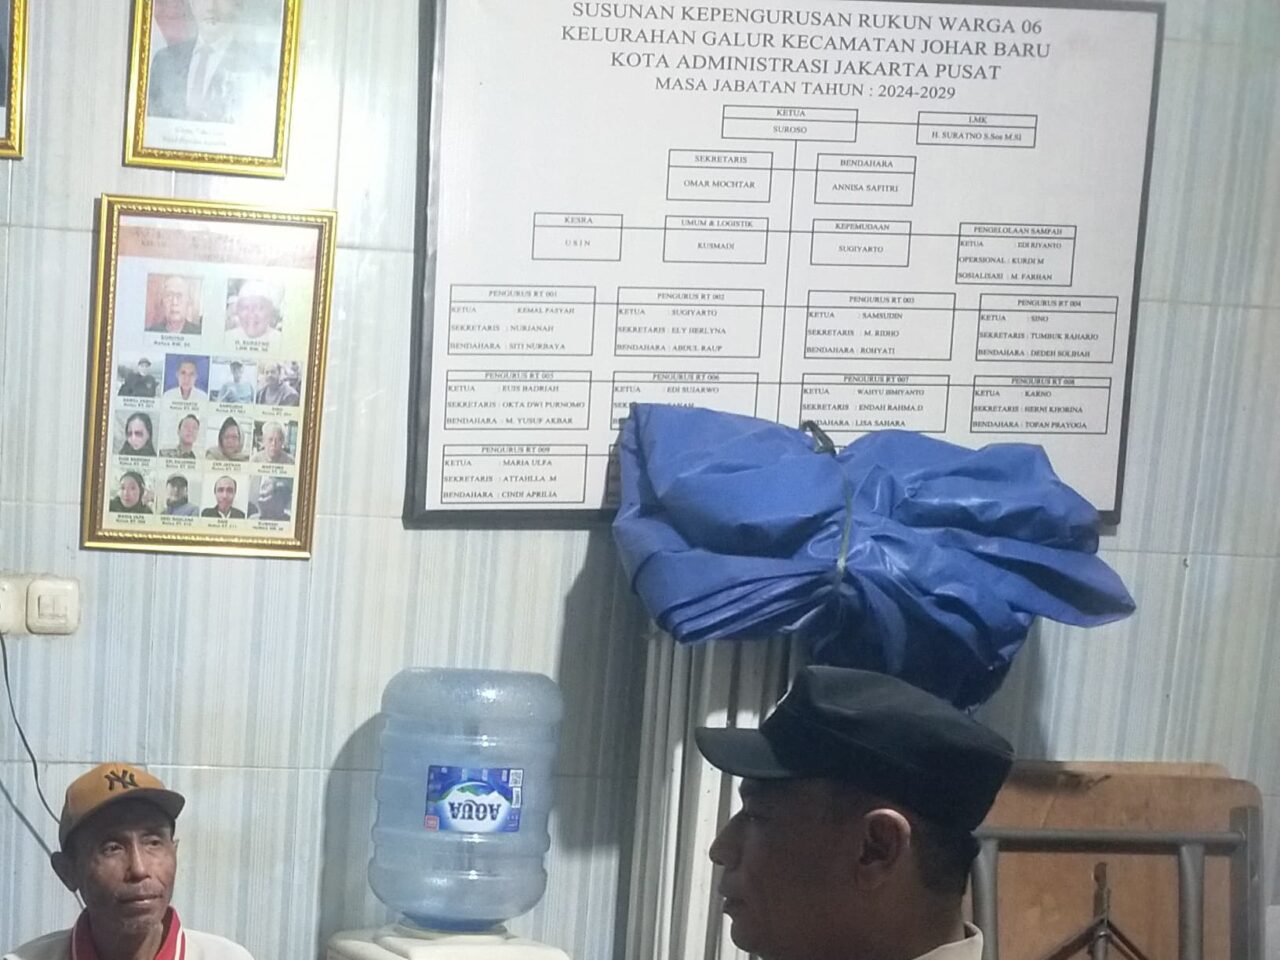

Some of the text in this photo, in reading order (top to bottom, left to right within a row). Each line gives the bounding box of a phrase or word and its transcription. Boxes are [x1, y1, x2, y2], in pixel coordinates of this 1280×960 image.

[572, 2, 1042, 35] SUSUNAN KEPENGURUSAN RUKUN WARGA 06
[561, 25, 1051, 58] KELURAHAN GALUR KECAMATAN JOHAR BARU
[610, 52, 1002, 81] KOTA ADMINISTRASI JAKARTA PUSAT
[655, 77, 956, 100] MASA JABATAN TAHUN 2024-2029
[776, 109, 806, 118] KETUA
[772, 125, 808, 134] SUROSO
[694, 155, 748, 164] SEKRETARIS
[840, 159, 894, 168] BENDAHARA
[683, 179, 755, 189] OMAR MOCHTAR
[681, 219, 707, 227] UMUM
[835, 223, 890, 231] KEPEMUDAAN
[838, 245, 884, 253] SUGIYARTO
[448, 799, 501, 821] AQUA
